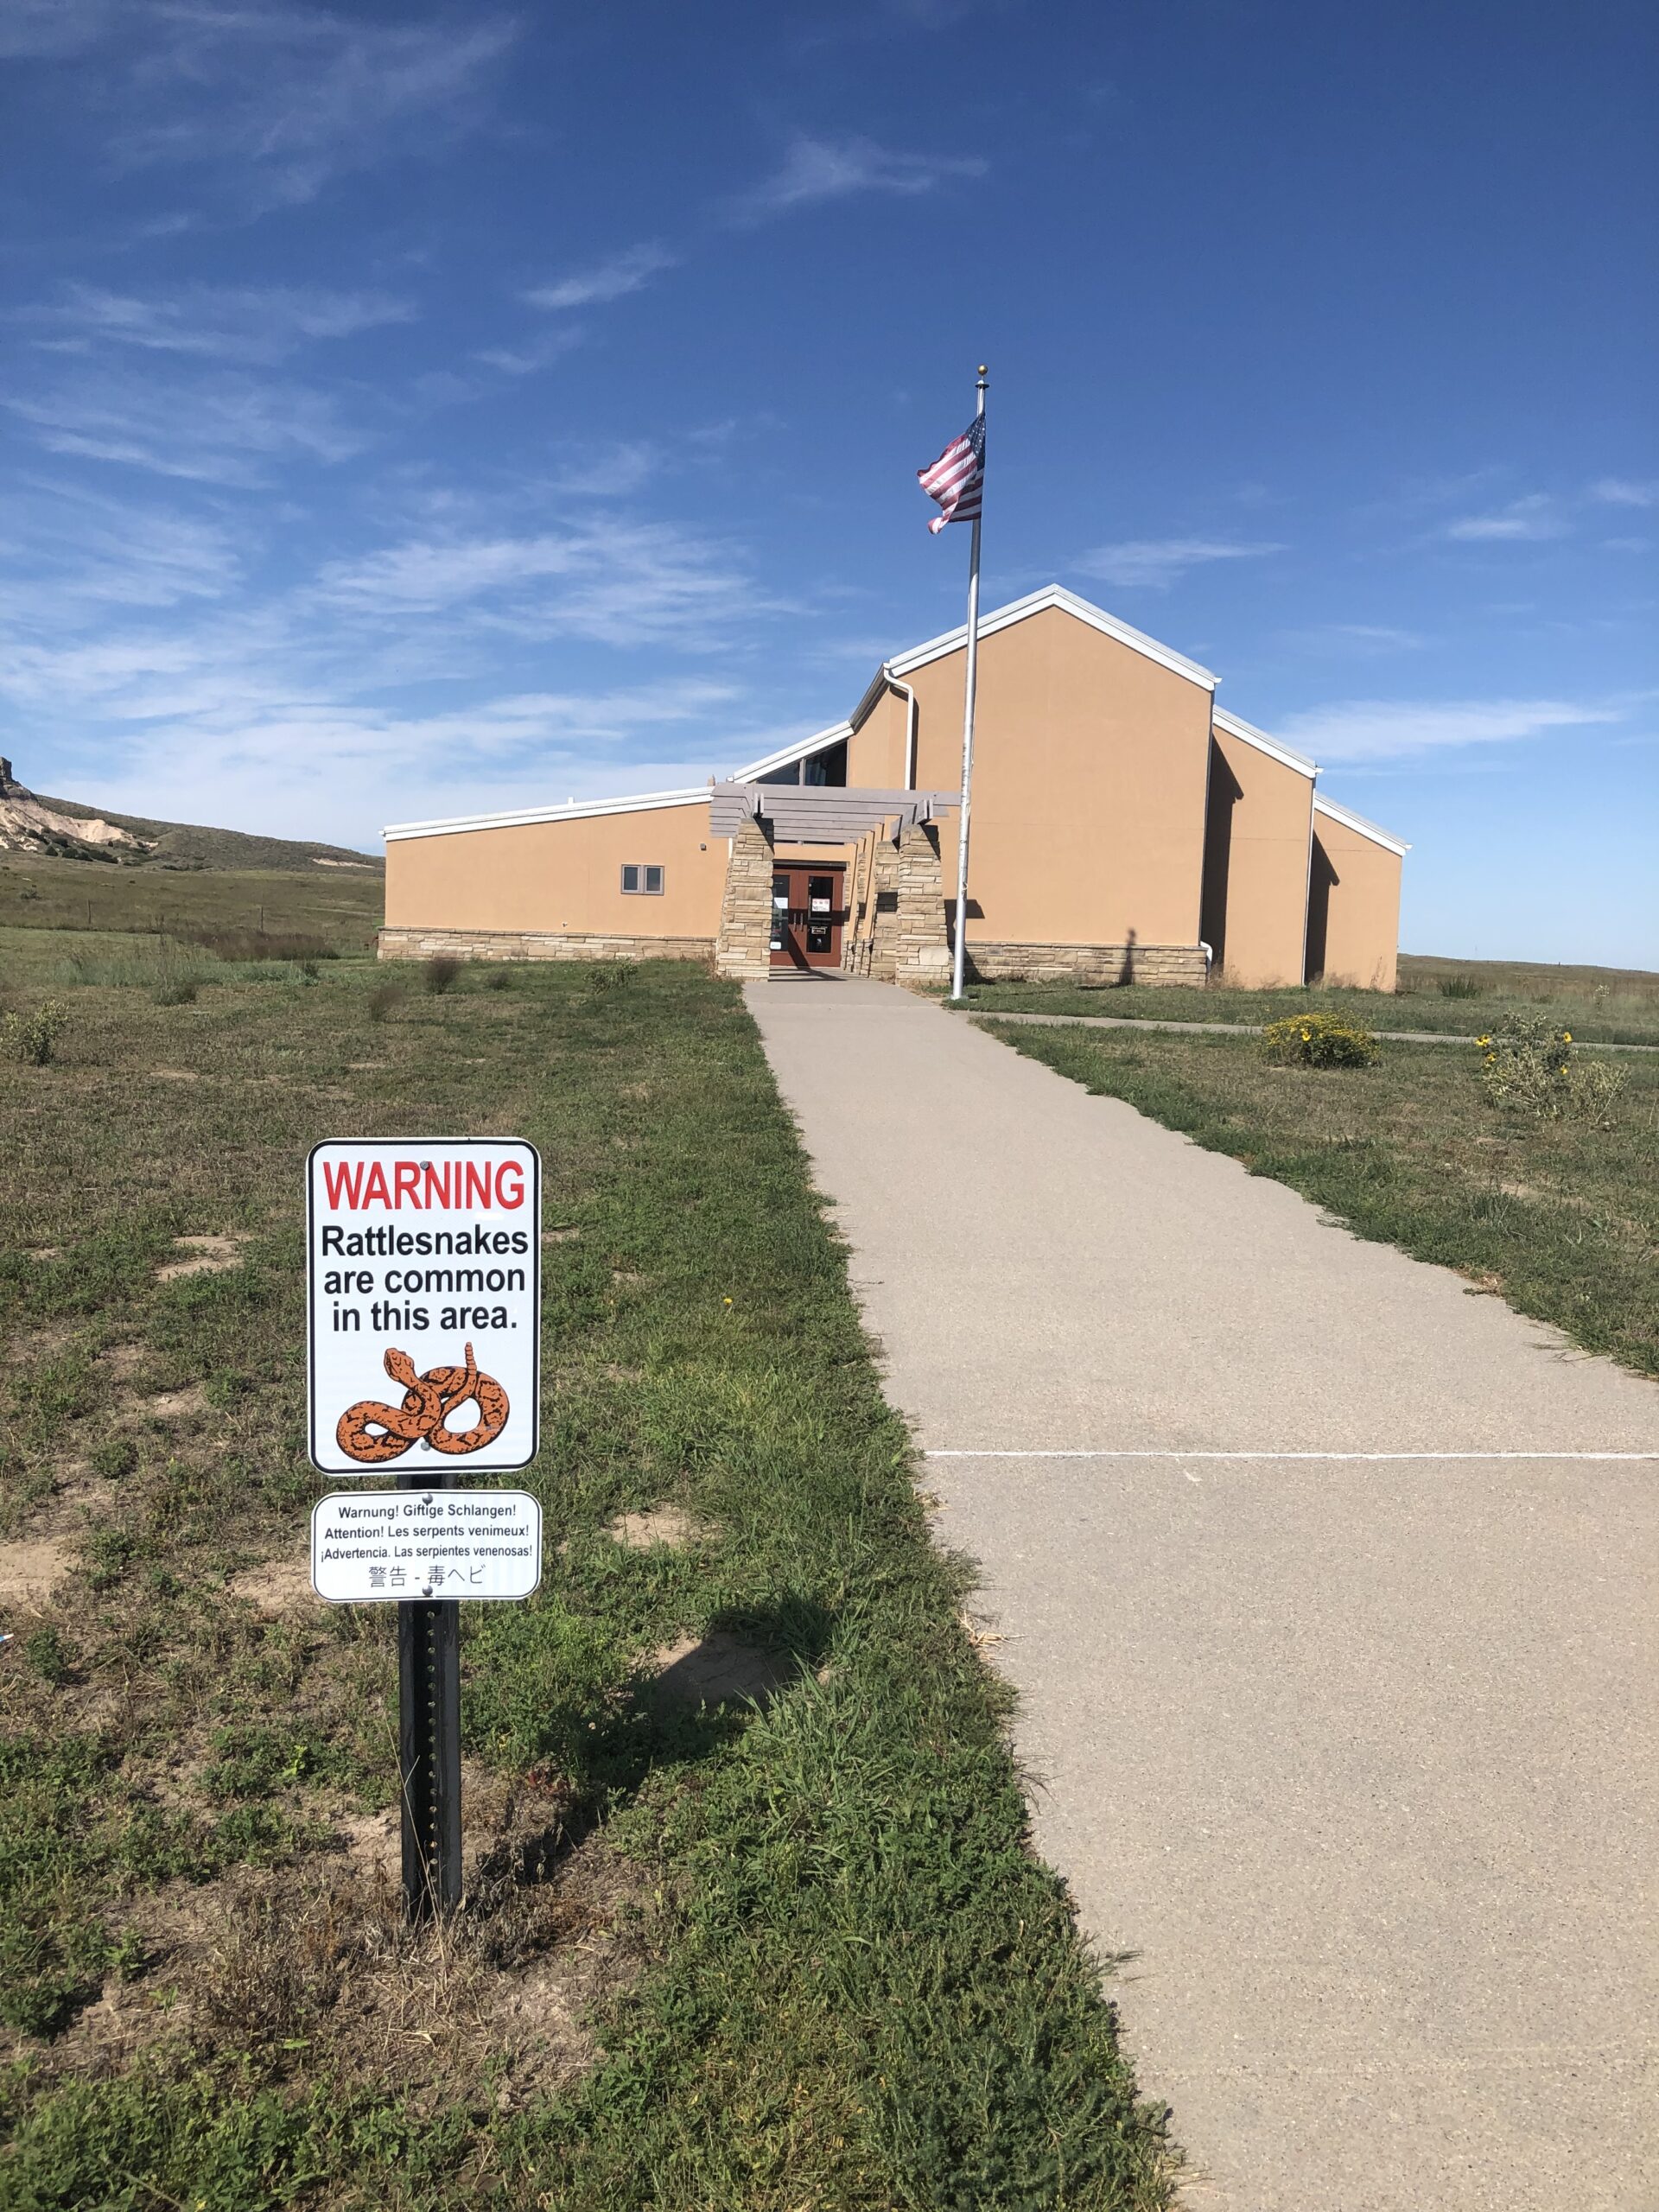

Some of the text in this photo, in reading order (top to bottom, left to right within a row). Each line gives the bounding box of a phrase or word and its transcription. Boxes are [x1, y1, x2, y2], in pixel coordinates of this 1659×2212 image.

[323, 1160, 524, 1210] WARNING
[322, 1224, 528, 1256] Rattlesnakes
[324, 1269, 524, 1294] are common
[334, 1300, 516, 1332] in this area.
[339, 1504, 515, 1520] Warnung! Giftige Schlangen!
[325, 1525, 529, 1539] Attention! Les serpents venimeux!
[321, 1545, 531, 1562] ¡Advertencia. Las serpientes venenosas!
[369, 1567, 406, 1587] 警告
